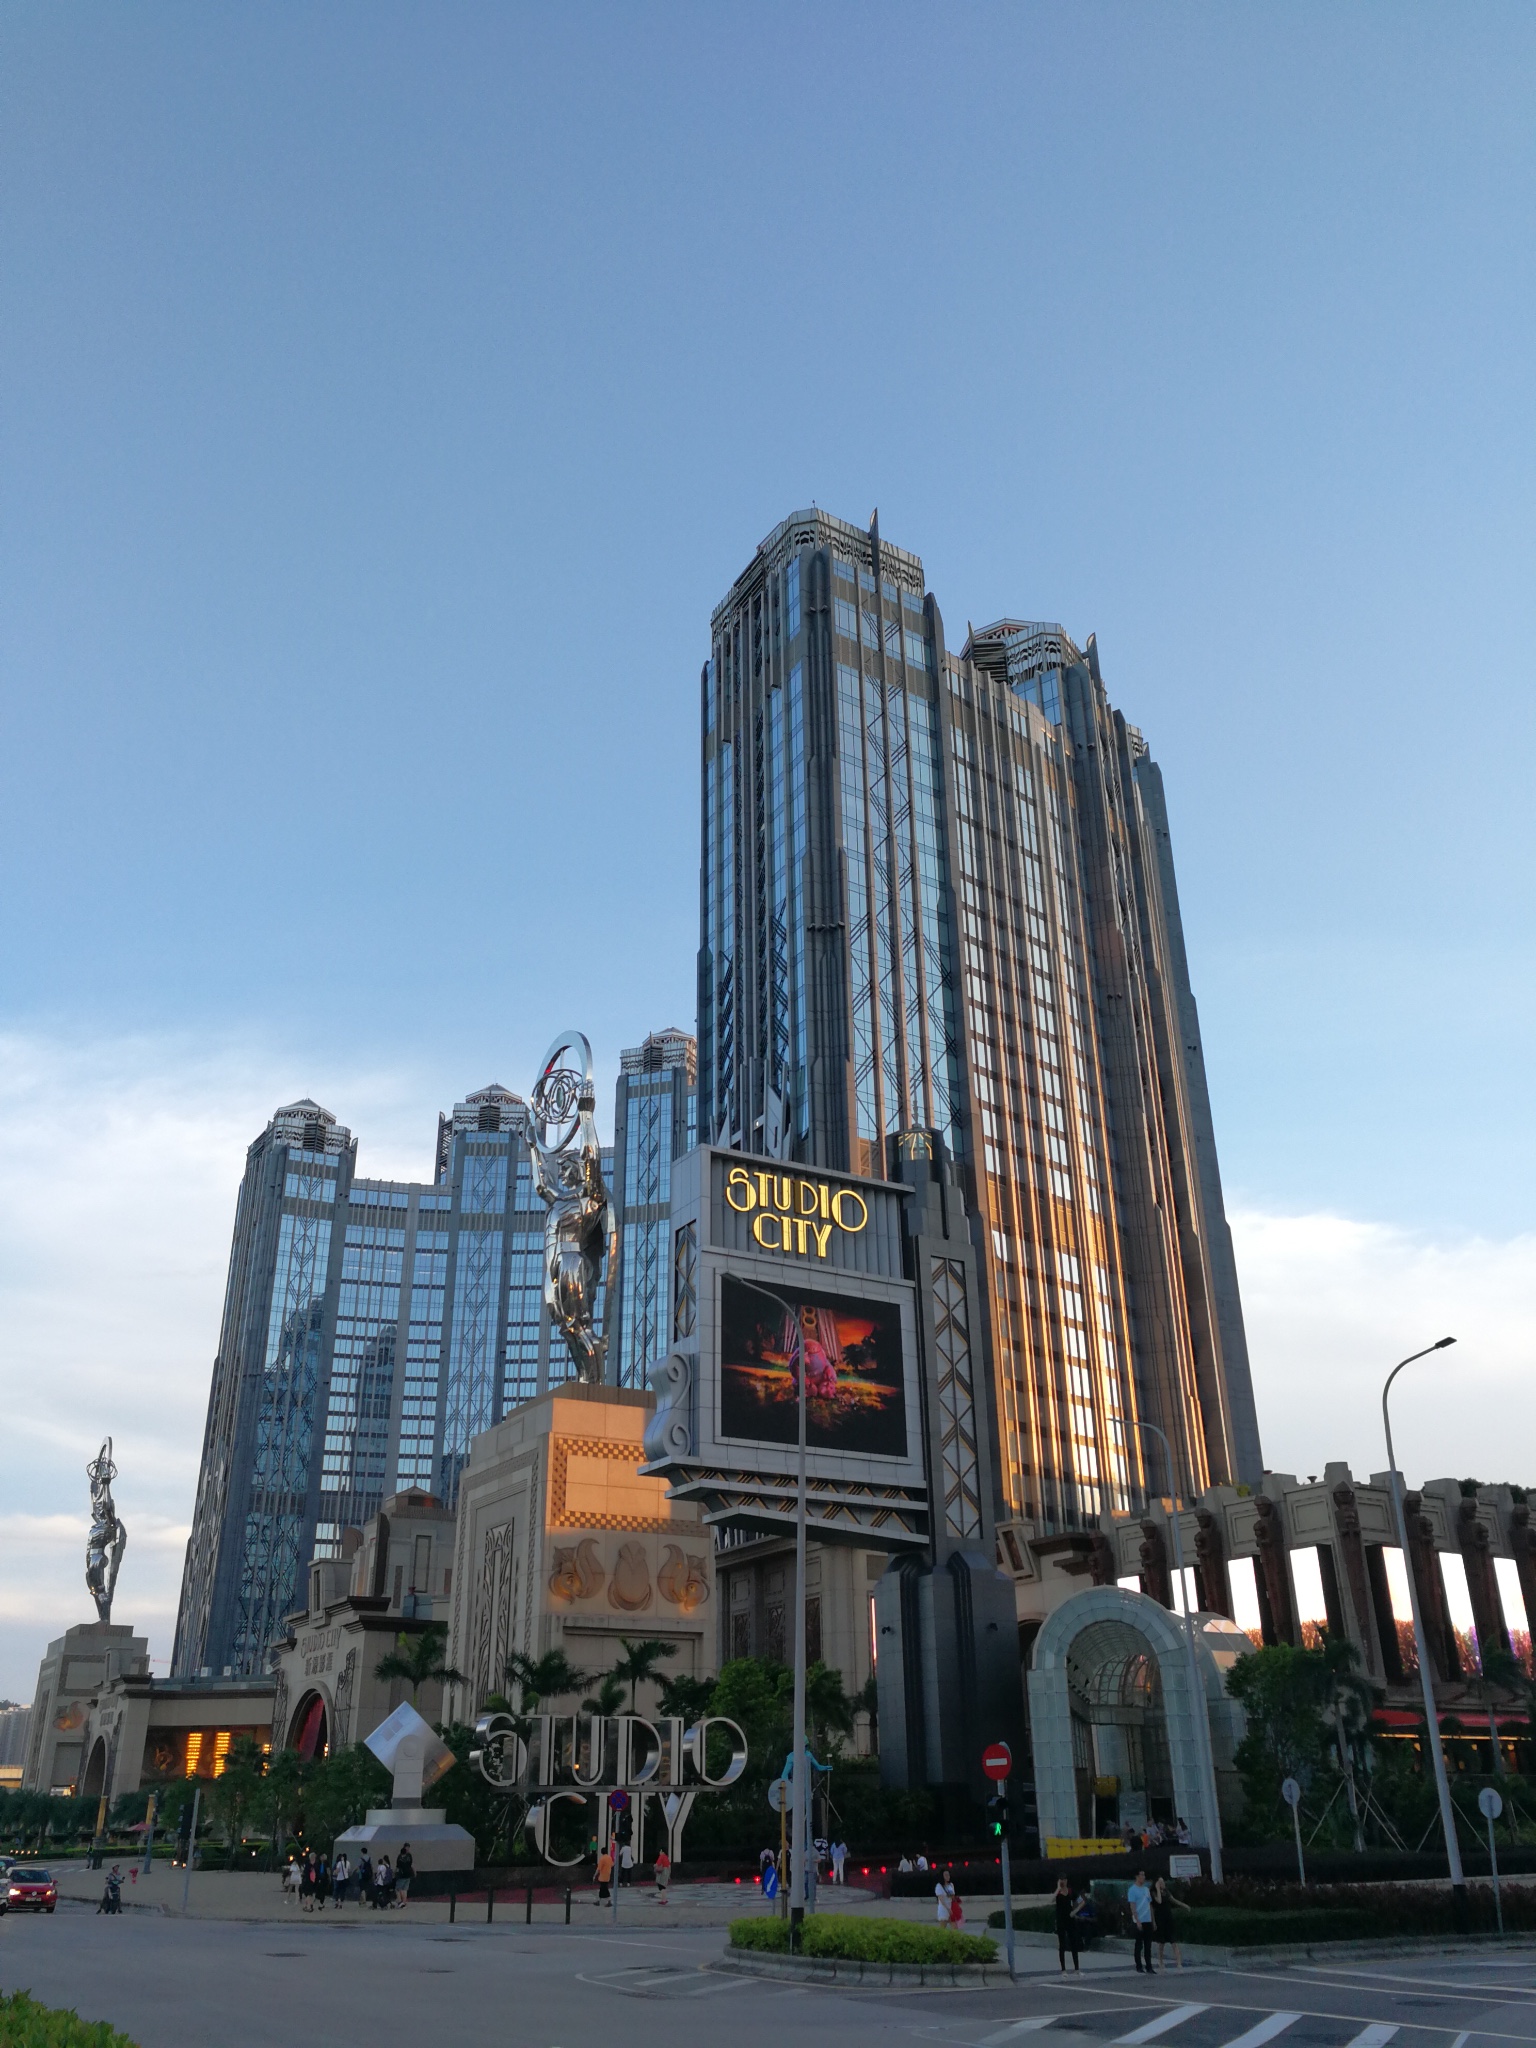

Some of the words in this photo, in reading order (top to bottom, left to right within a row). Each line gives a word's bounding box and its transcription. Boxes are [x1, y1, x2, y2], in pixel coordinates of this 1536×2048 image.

[726, 1167, 868, 1232] STUDIO
[752, 1213, 832, 1257] CITY
[469, 1713, 748, 1786] STUDIO
[526, 1792, 696, 1866] CITY
